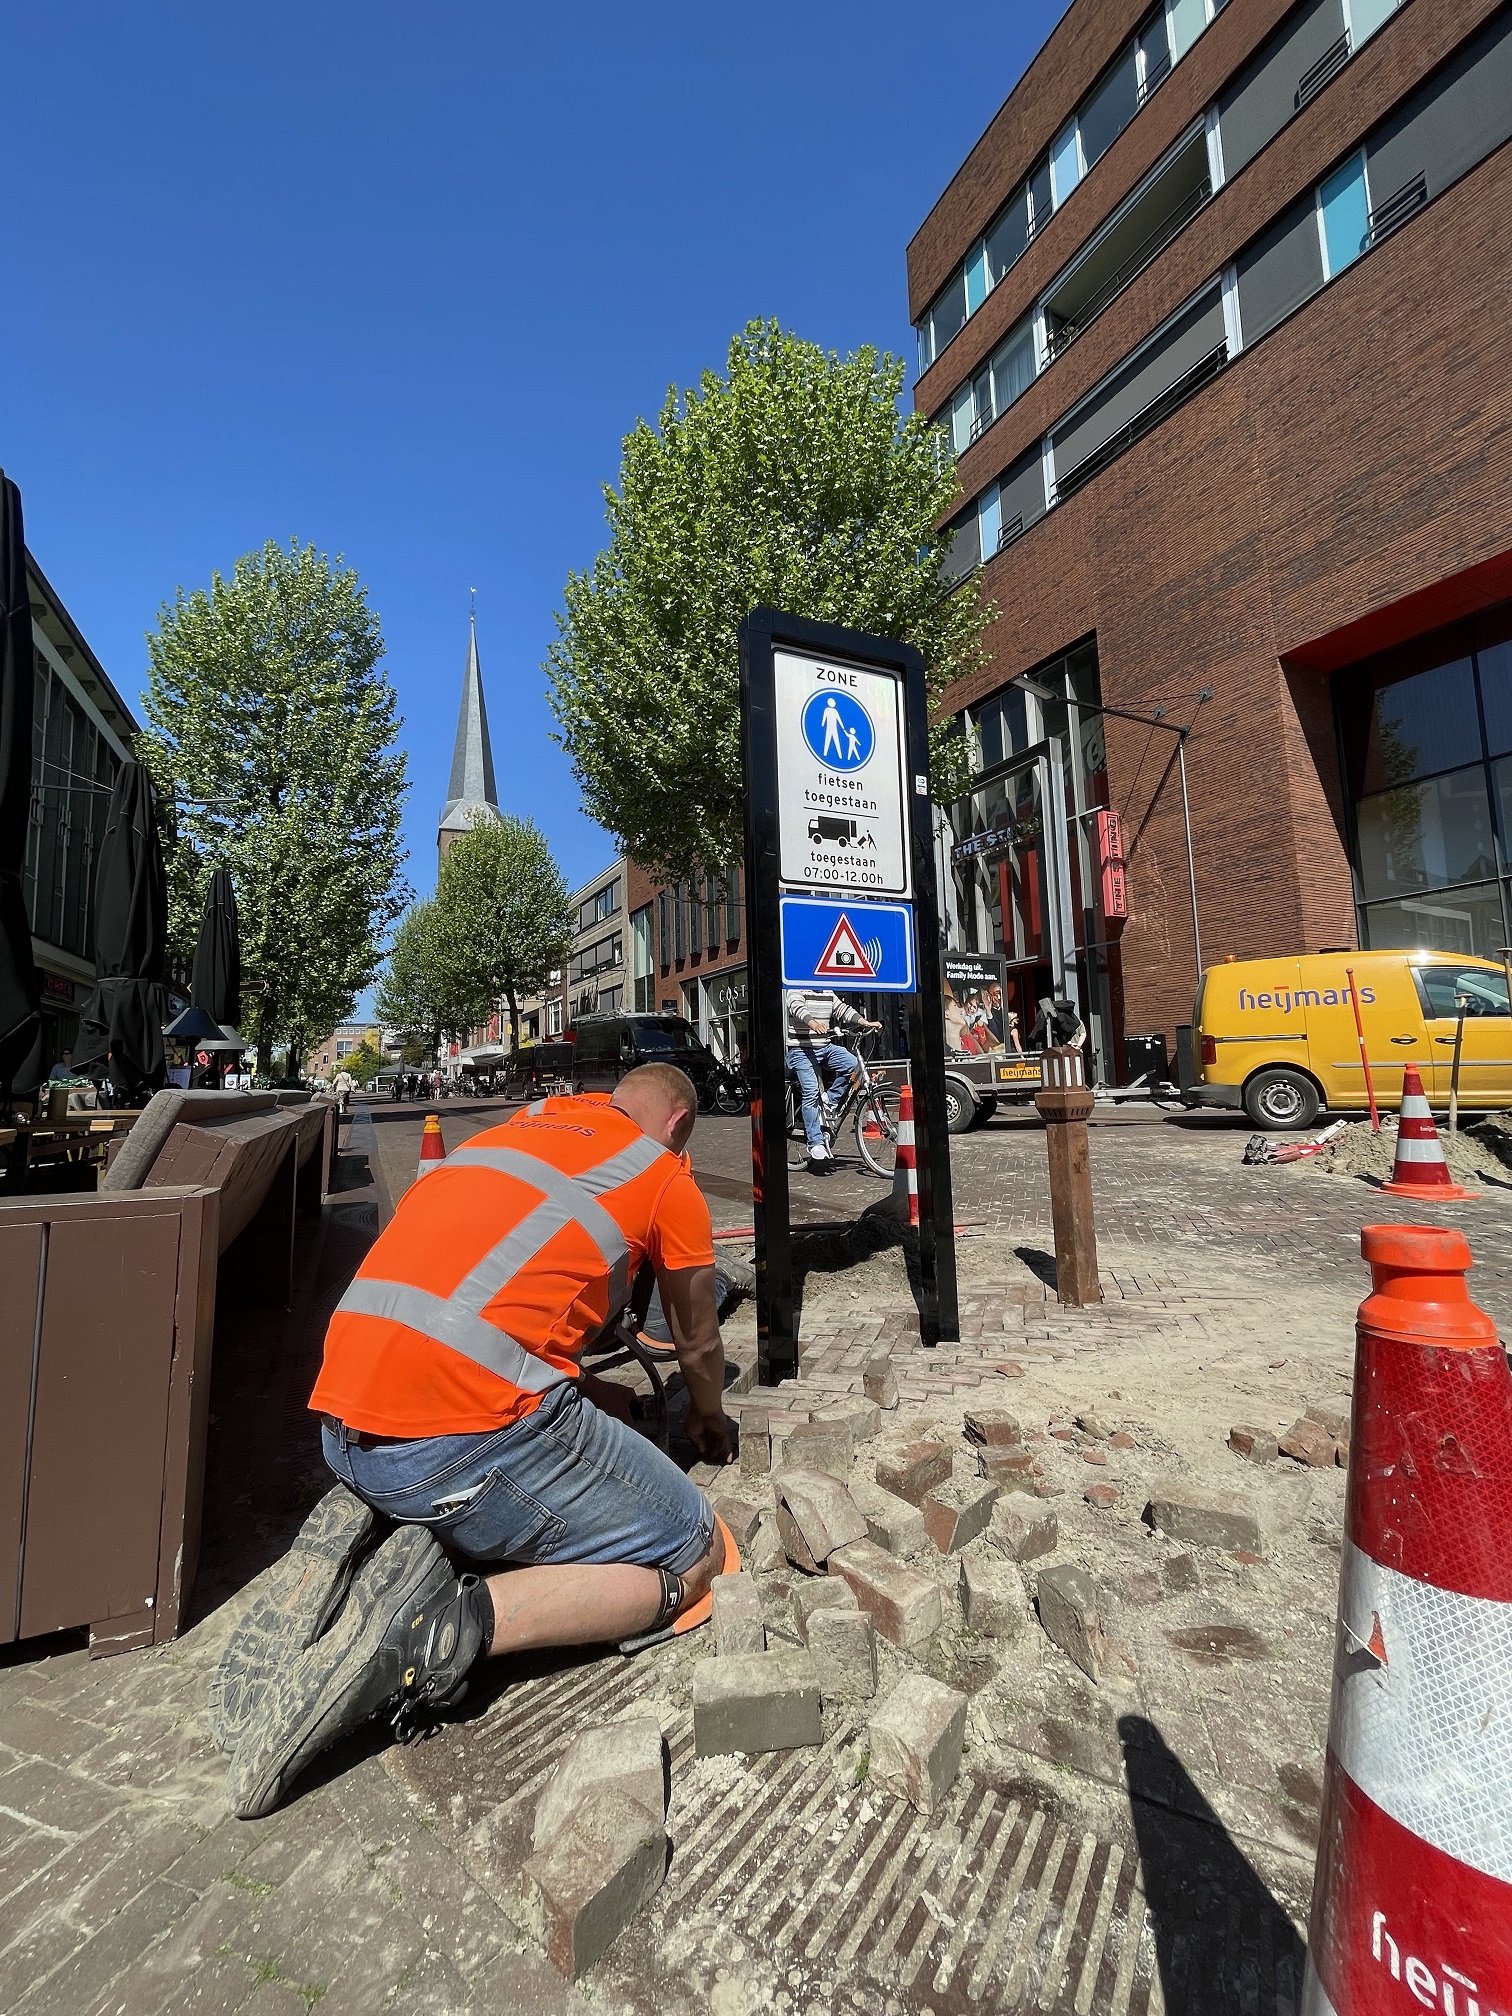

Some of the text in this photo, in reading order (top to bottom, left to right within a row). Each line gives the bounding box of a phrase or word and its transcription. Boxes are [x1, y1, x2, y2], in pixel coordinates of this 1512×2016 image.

[815, 667, 858, 688] ZONE
[817, 773, 863, 791] fietsen
[804, 789, 877, 811] toegestaan
[954, 839, 984, 859] THE
[810, 850, 876, 868] toegestaan
[803, 866, 884, 885] 07:00-12.00h
[945, 961, 984, 972] Werkdag uit.
[946, 970, 998, 981] Family Mode aan.
[1239, 985, 1376, 1014] heijmans
[1002, 1067, 1042, 1078] heijmans
